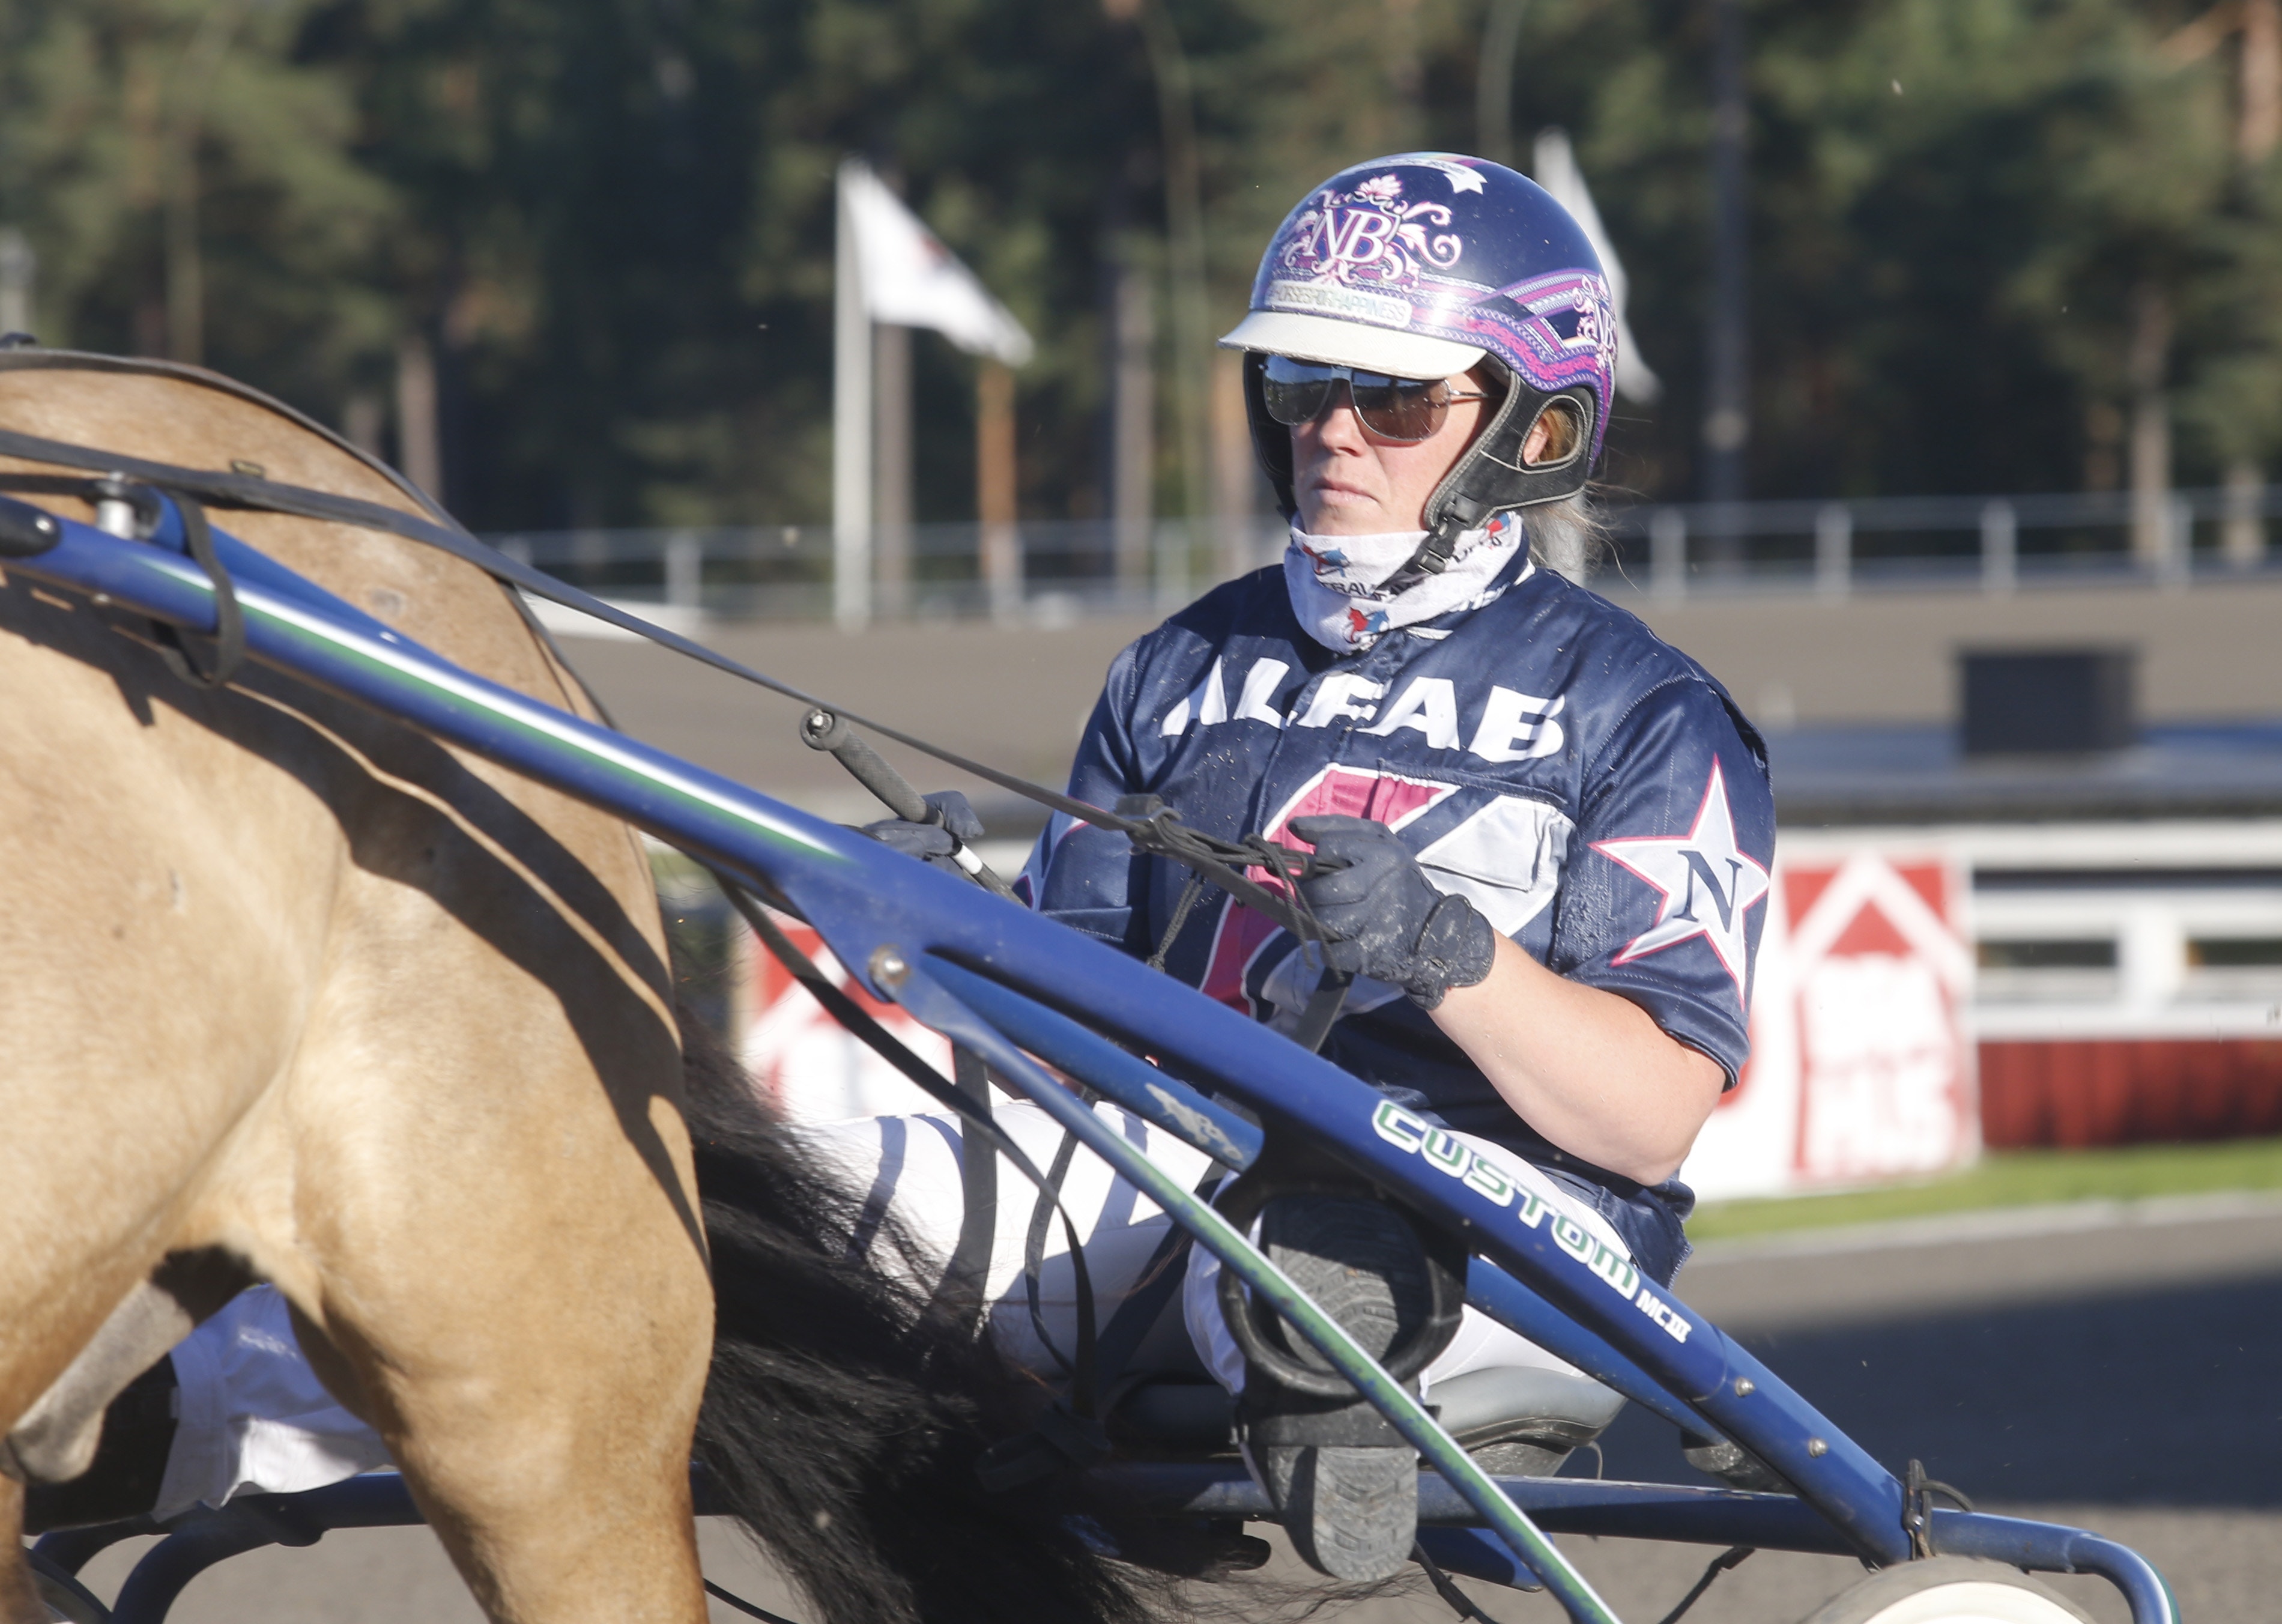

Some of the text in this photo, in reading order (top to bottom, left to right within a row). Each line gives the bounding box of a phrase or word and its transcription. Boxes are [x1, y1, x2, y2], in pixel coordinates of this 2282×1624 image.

[1303, 208, 1392, 263] NB
[1158, 654, 1565, 763] ALFAB
[1672, 850, 1743, 933] N
[1372, 1098, 1641, 1301] CUSTOM
